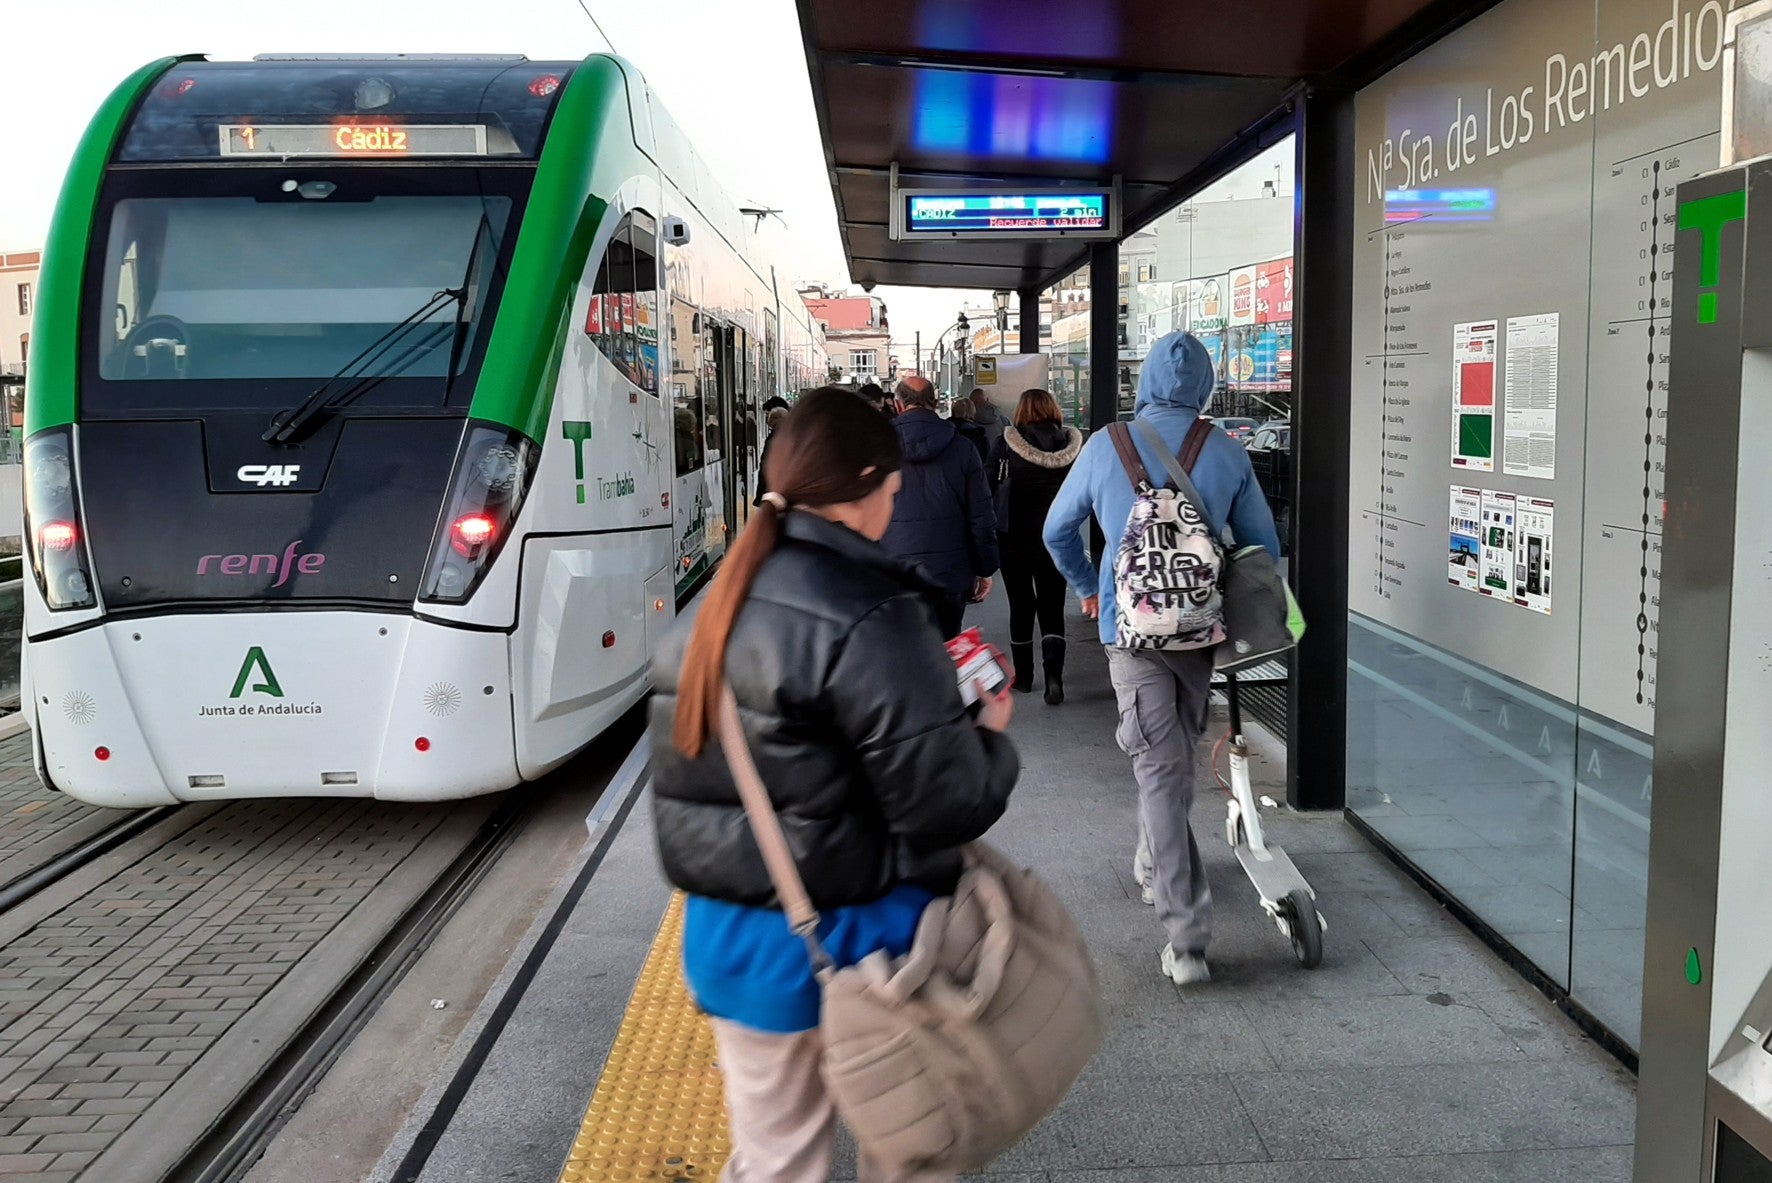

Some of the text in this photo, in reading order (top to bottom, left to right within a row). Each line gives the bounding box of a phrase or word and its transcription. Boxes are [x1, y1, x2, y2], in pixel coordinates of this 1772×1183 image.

[1398, 129, 1438, 191] Sra.
[1446, 98, 1478, 171] de
[1486, 87, 1534, 157] Los
[1545, 0, 1735, 133] Remedio
[241, 126, 407, 150] 1 Cádiz
[1665, 157, 1680, 170] Cádiz
[1060, 207, 1068, 217] 2
[237, 465, 300, 486] CAF
[196, 540, 326, 588] renfe
[199, 701, 322, 716] Junta de Andalucía
